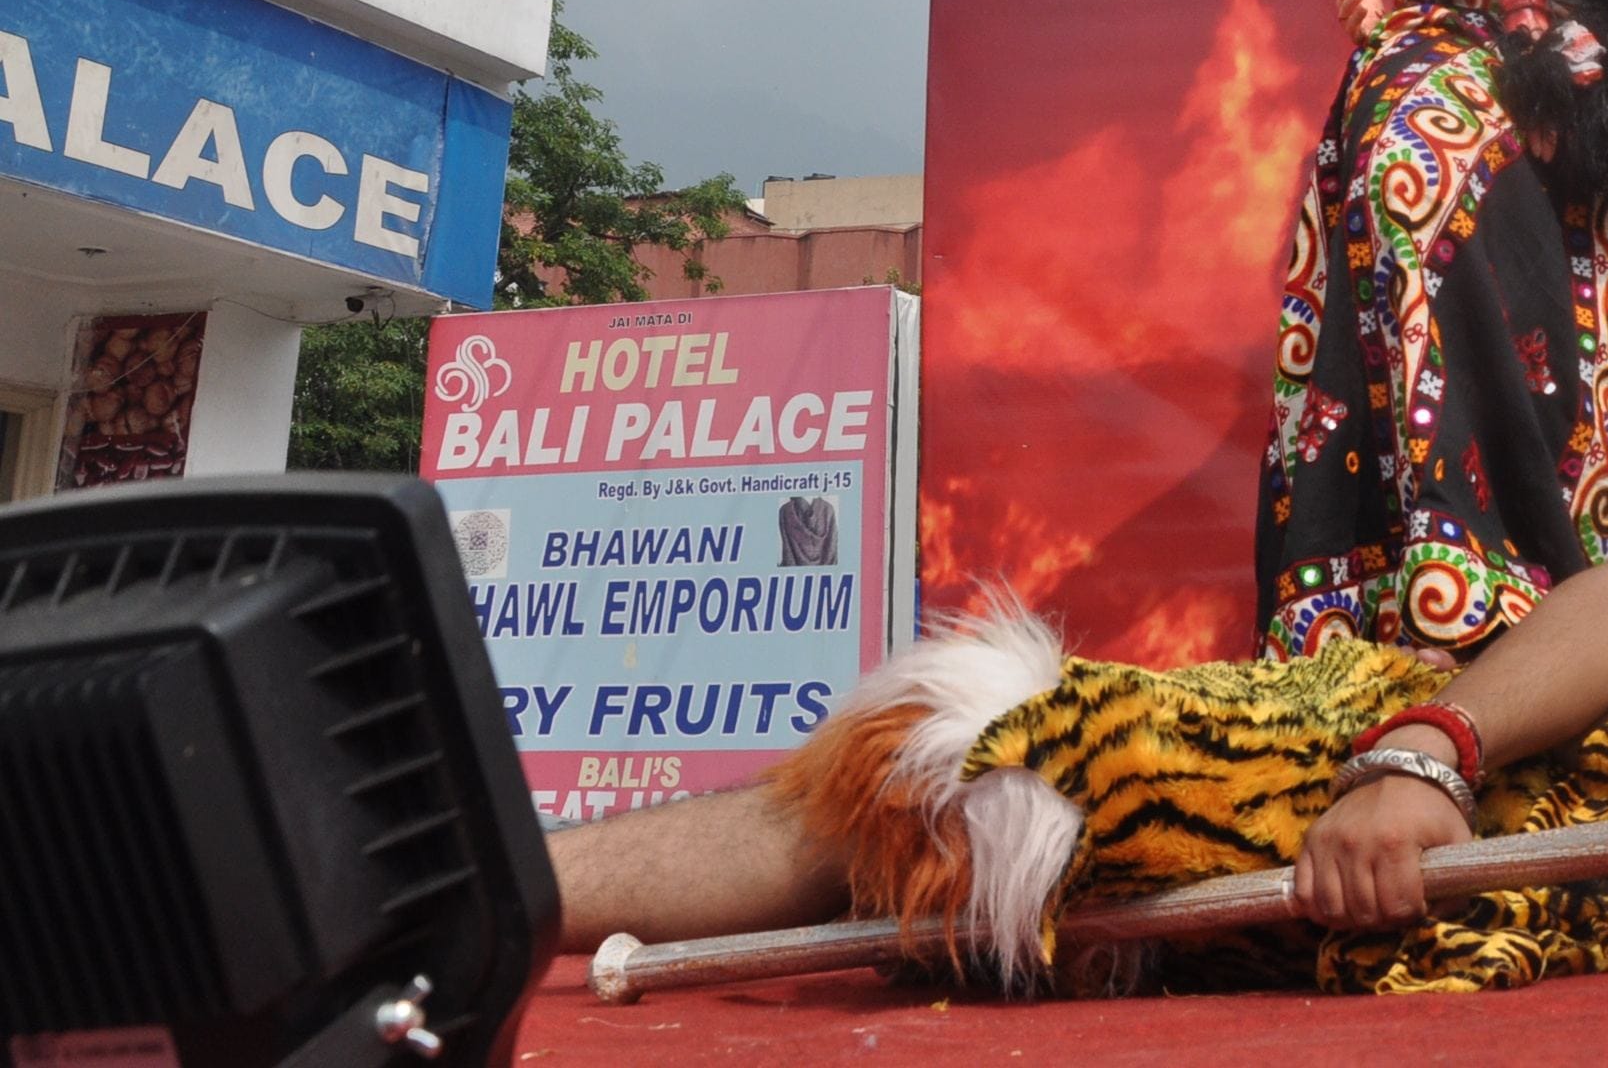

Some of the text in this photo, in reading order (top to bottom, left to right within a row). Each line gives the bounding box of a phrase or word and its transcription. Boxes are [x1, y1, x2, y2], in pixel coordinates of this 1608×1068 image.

[0, 30, 429, 258] ALACE
[609, 313, 692, 329] JAI MATA DI
[560, 332, 739, 393] HOTEL
[436, 391, 873, 470] BALI PALACE
[598, 472, 851, 501] Regd. By J&k Govt. Handicraft j-15
[541, 525, 745, 568] BHAWANI
[469, 573, 854, 638] HAWL EMPORIUM
[498, 682, 834, 736] RY FRUITS
[577, 756, 682, 788] BALI'S
